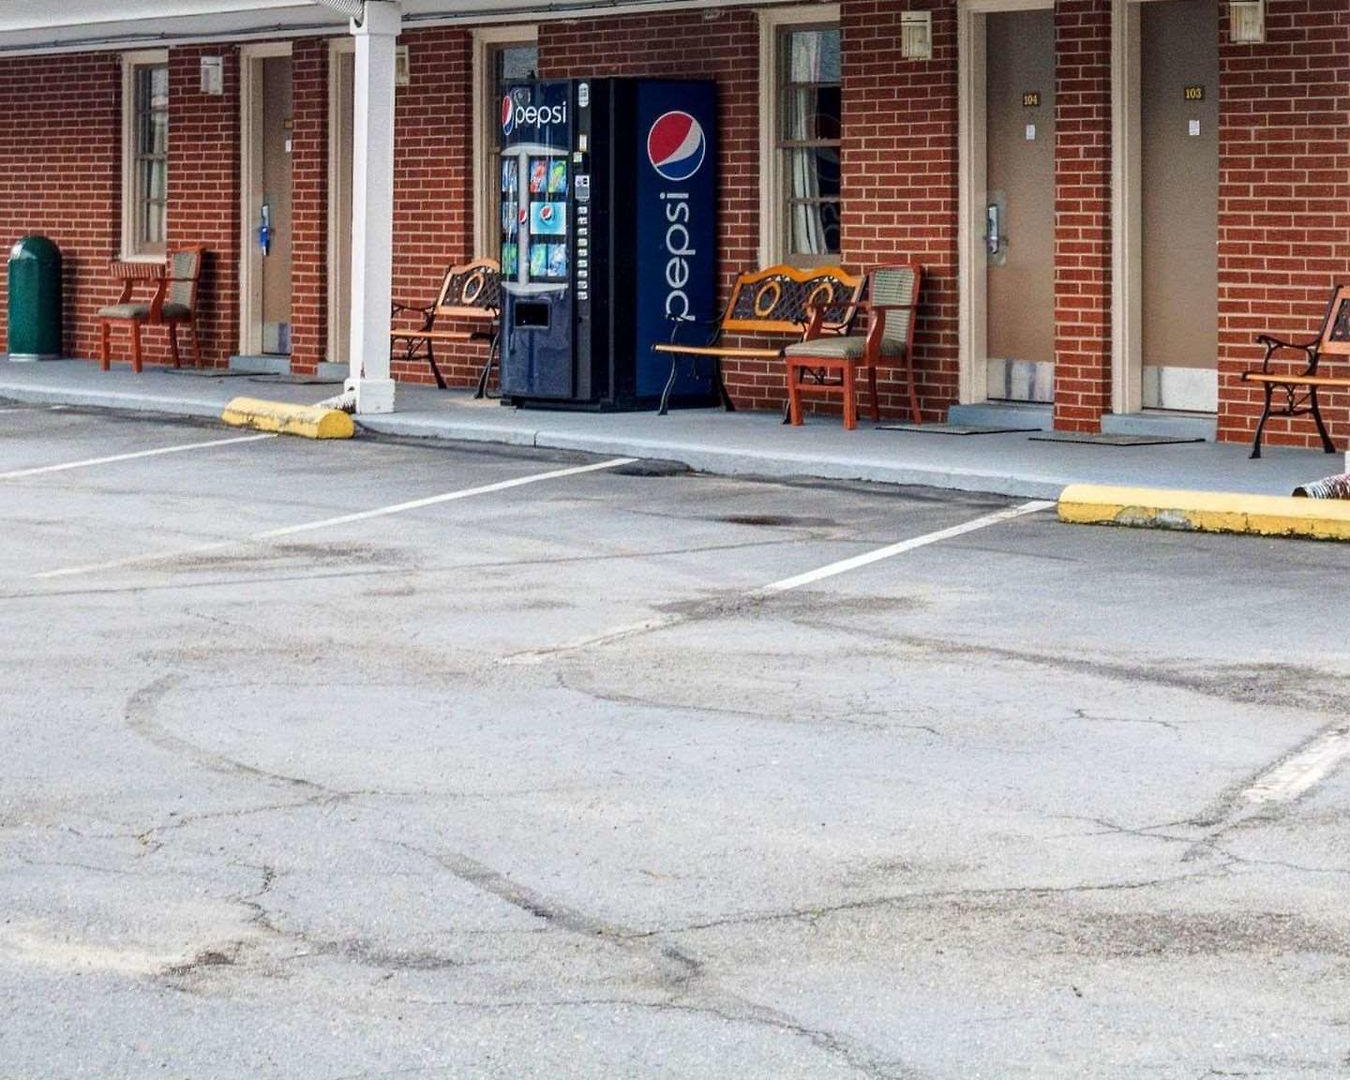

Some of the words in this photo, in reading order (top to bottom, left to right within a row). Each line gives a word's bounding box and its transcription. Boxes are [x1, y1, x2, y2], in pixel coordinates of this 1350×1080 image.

[1024, 94, 1038, 105] 104
[1186, 88, 1201, 99] 103
[514, 101, 567, 129] pepsi
[660, 192, 696, 321] pepsi
